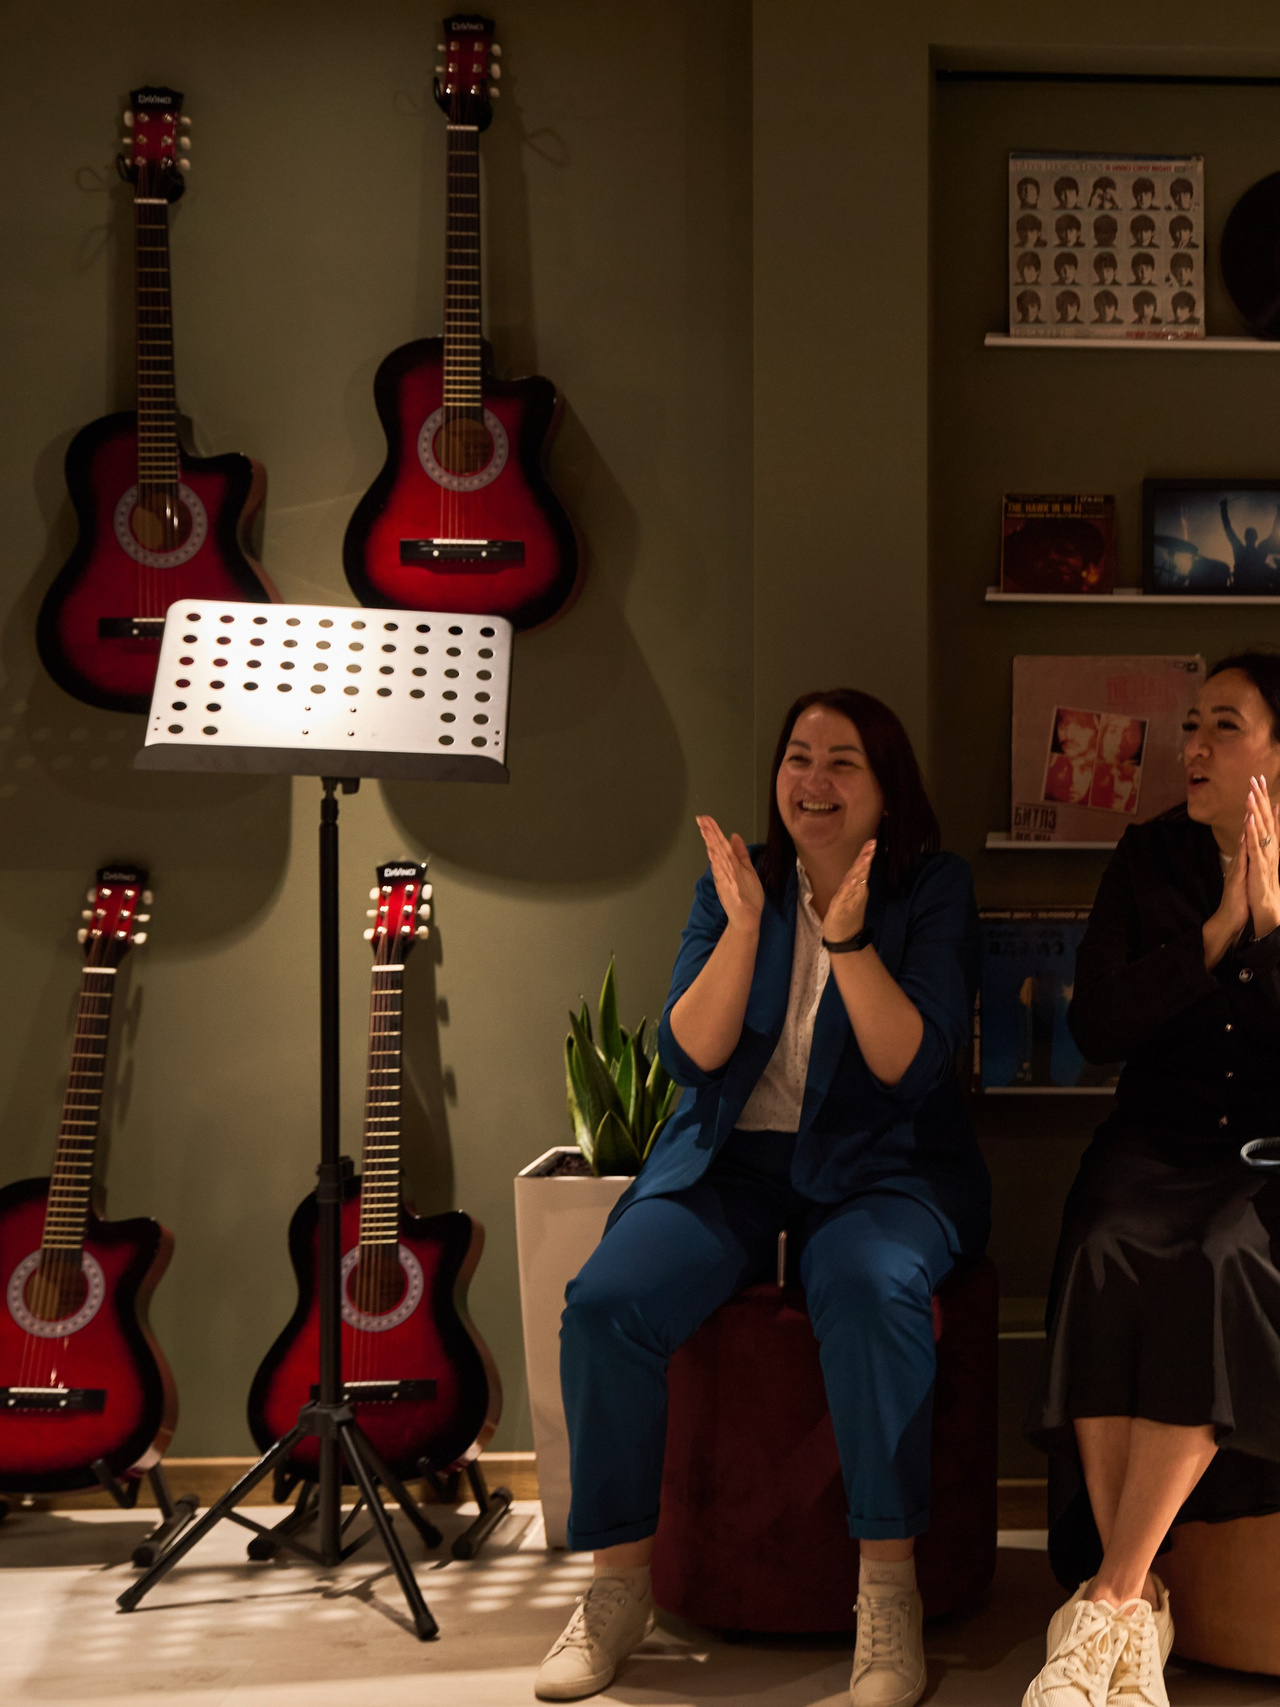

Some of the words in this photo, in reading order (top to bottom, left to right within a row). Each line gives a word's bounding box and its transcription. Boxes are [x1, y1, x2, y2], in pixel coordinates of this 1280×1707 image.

[1007, 502, 1023, 513] THE
[1024, 502, 1049, 513] HAWK
[1014, 806, 1057, 829] БИТЛЗ
